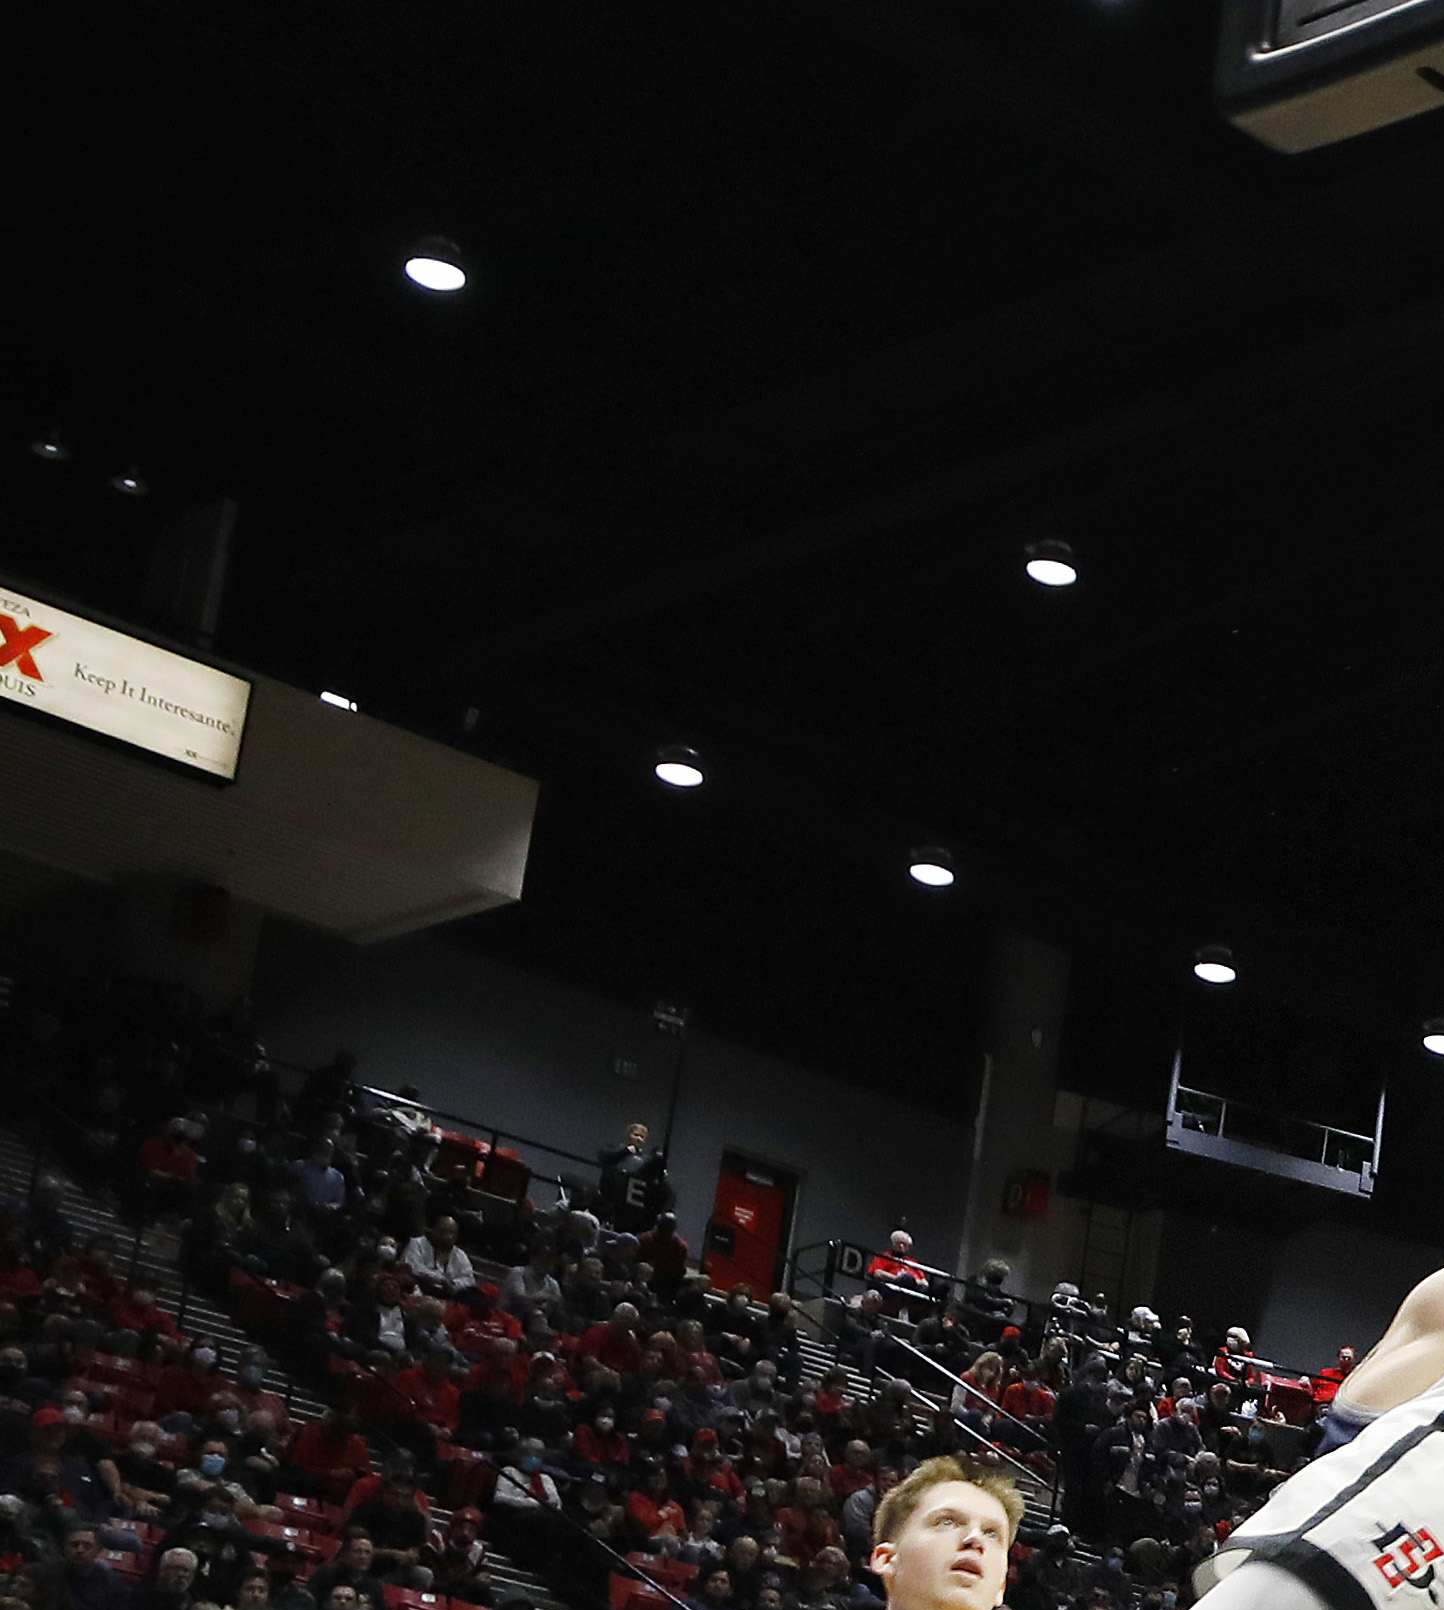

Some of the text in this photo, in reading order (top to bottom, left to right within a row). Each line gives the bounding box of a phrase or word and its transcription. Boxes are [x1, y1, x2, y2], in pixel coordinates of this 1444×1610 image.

[74, 662, 236, 737] Keep It Interesante.
[625, 1176, 648, 1208] E
[841, 1245, 864, 1275] D
